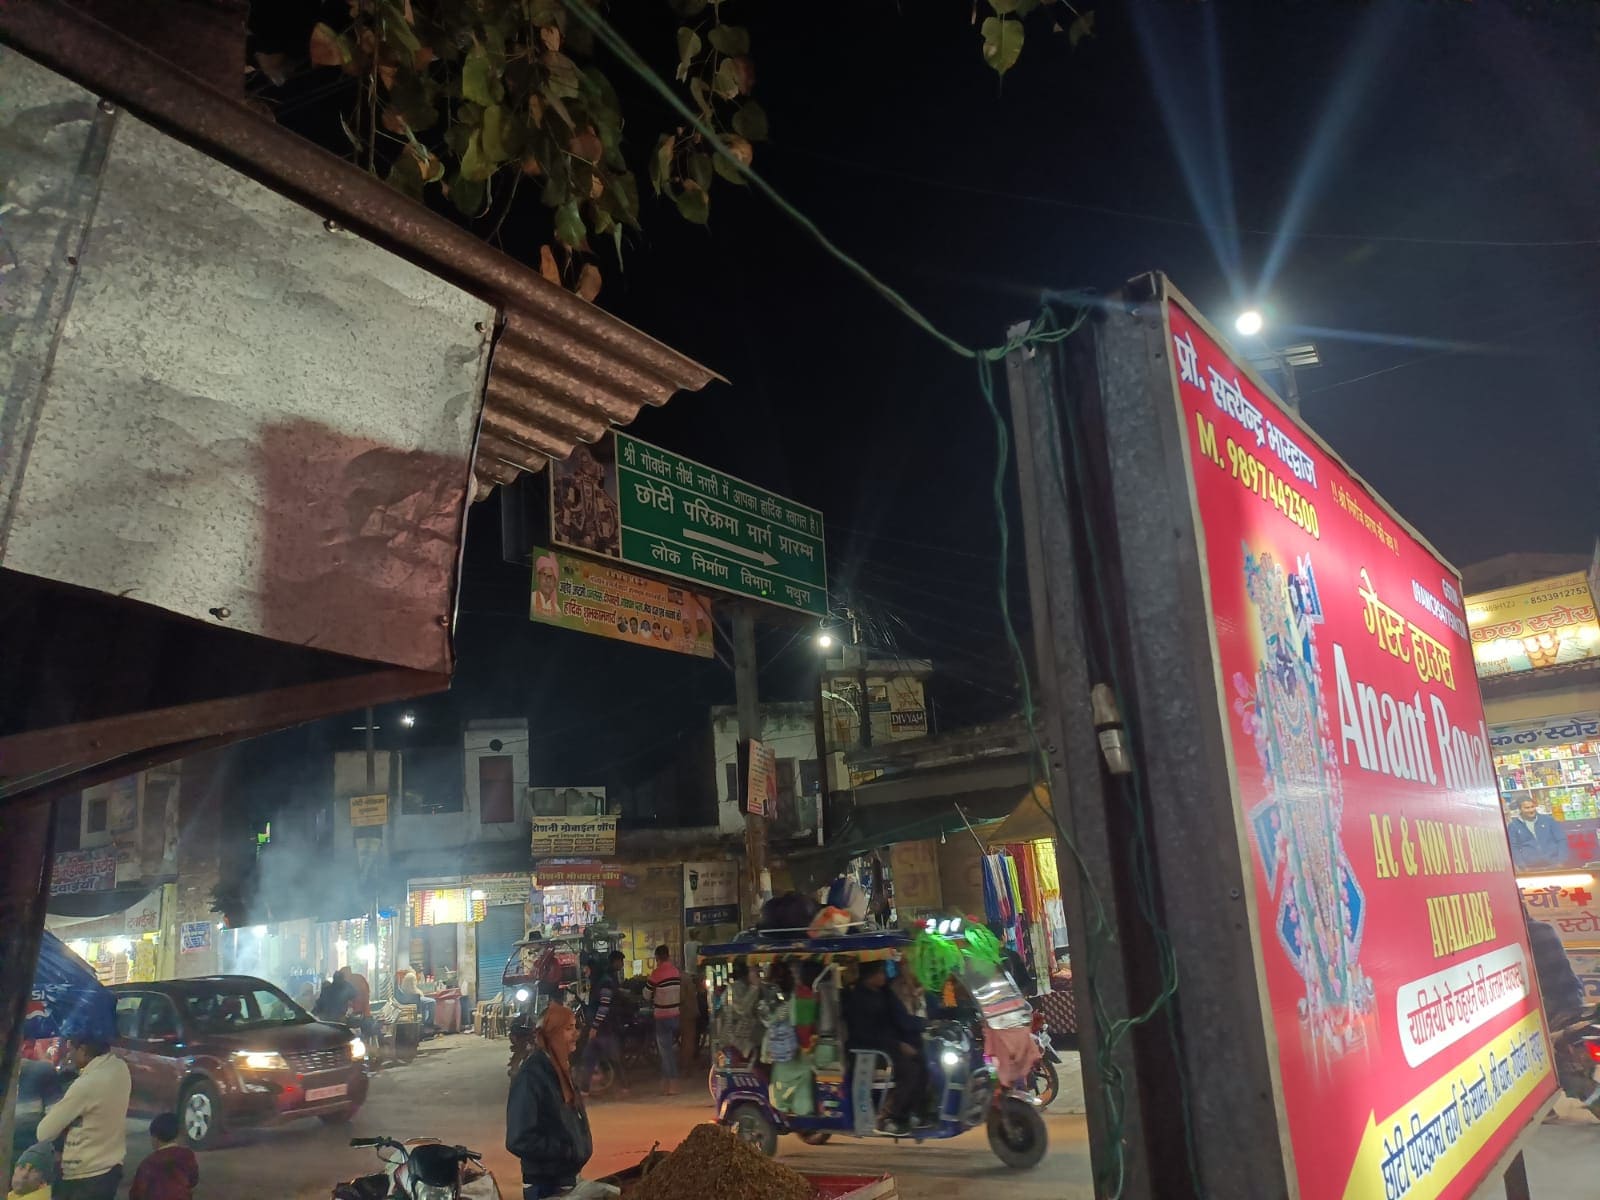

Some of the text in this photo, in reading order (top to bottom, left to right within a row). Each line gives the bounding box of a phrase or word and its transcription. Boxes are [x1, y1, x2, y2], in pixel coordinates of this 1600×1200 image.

[1174, 332, 1318, 489] प्रो. सत्येन्द्र भारद्वाज
[624, 442, 635, 466] श्री
[641, 448, 672, 478] गोवर्धन
[676, 461, 693, 487] तीर्थ
[697, 474, 718, 496] नगरी
[722, 480, 730, 499] में
[733, 488, 757, 510] आपका
[760, 497, 782, 519] हार्दिक
[785, 507, 807, 530] स्वागत
[1196, 412, 1320, 540] M. 9897442300
[634, 479, 814, 562] छोटी परिक्रमा मार्ग प्रारम्भ
[650, 542, 681, 564] लोक
[692, 552, 729, 579] निर्माण
[785, 584, 810, 606] मथुरा
[1530, 586, 1588, 605] 8533912753
[563, 598, 582, 618] हार्दिक
[1358, 566, 1410, 665] गेस्ट
[1407, 621, 1456, 692] हाउस
[1527, 604, 1596, 633] स्टोर
[1333, 643, 1438, 787] Anant
[1543, 717, 1599, 740] स्टोर
[1369, 812, 1399, 878] AC
[1400, 816, 1418, 876] &
[1415, 819, 1452, 876] NON
[1448, 823, 1469, 875] AC
[1426, 891, 1497, 958] AVAILABLE
[1443, 980, 1455, 1026] के
[1454, 971, 1479, 1024] ठहरने
[1476, 964, 1489, 1008] की
[1381, 1125, 1411, 1200] छोटी
[1407, 1113, 1446, 1179] परिक्रमा
[1442, 1083, 1462, 1145] मार्ग
[1460, 1078, 1471, 1127] के
